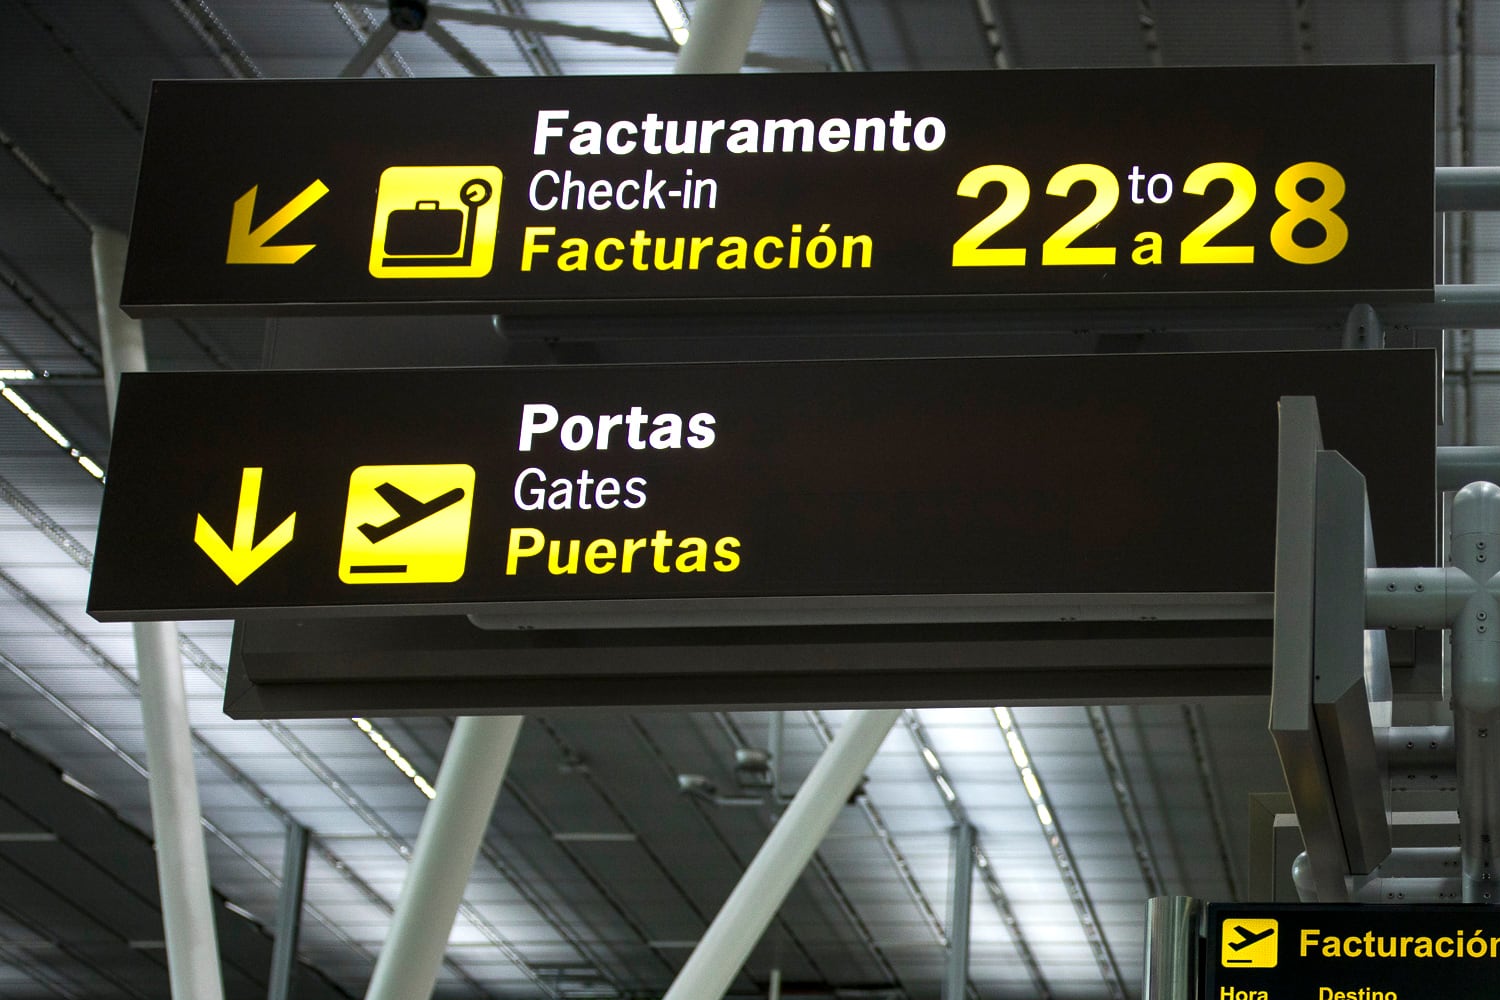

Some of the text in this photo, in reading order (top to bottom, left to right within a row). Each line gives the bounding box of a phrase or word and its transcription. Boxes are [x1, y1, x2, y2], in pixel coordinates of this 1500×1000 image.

[533, 109, 946, 156] Facturamento
[529, 168, 718, 211] Check-in
[951, 161, 1349, 267] 22 to 28
[520, 223, 873, 272] Facturación
[1131, 231, 1163, 266] a
[518, 403, 716, 452] Portas
[514, 467, 647, 511] Gates
[505, 527, 741, 576] Puertas
